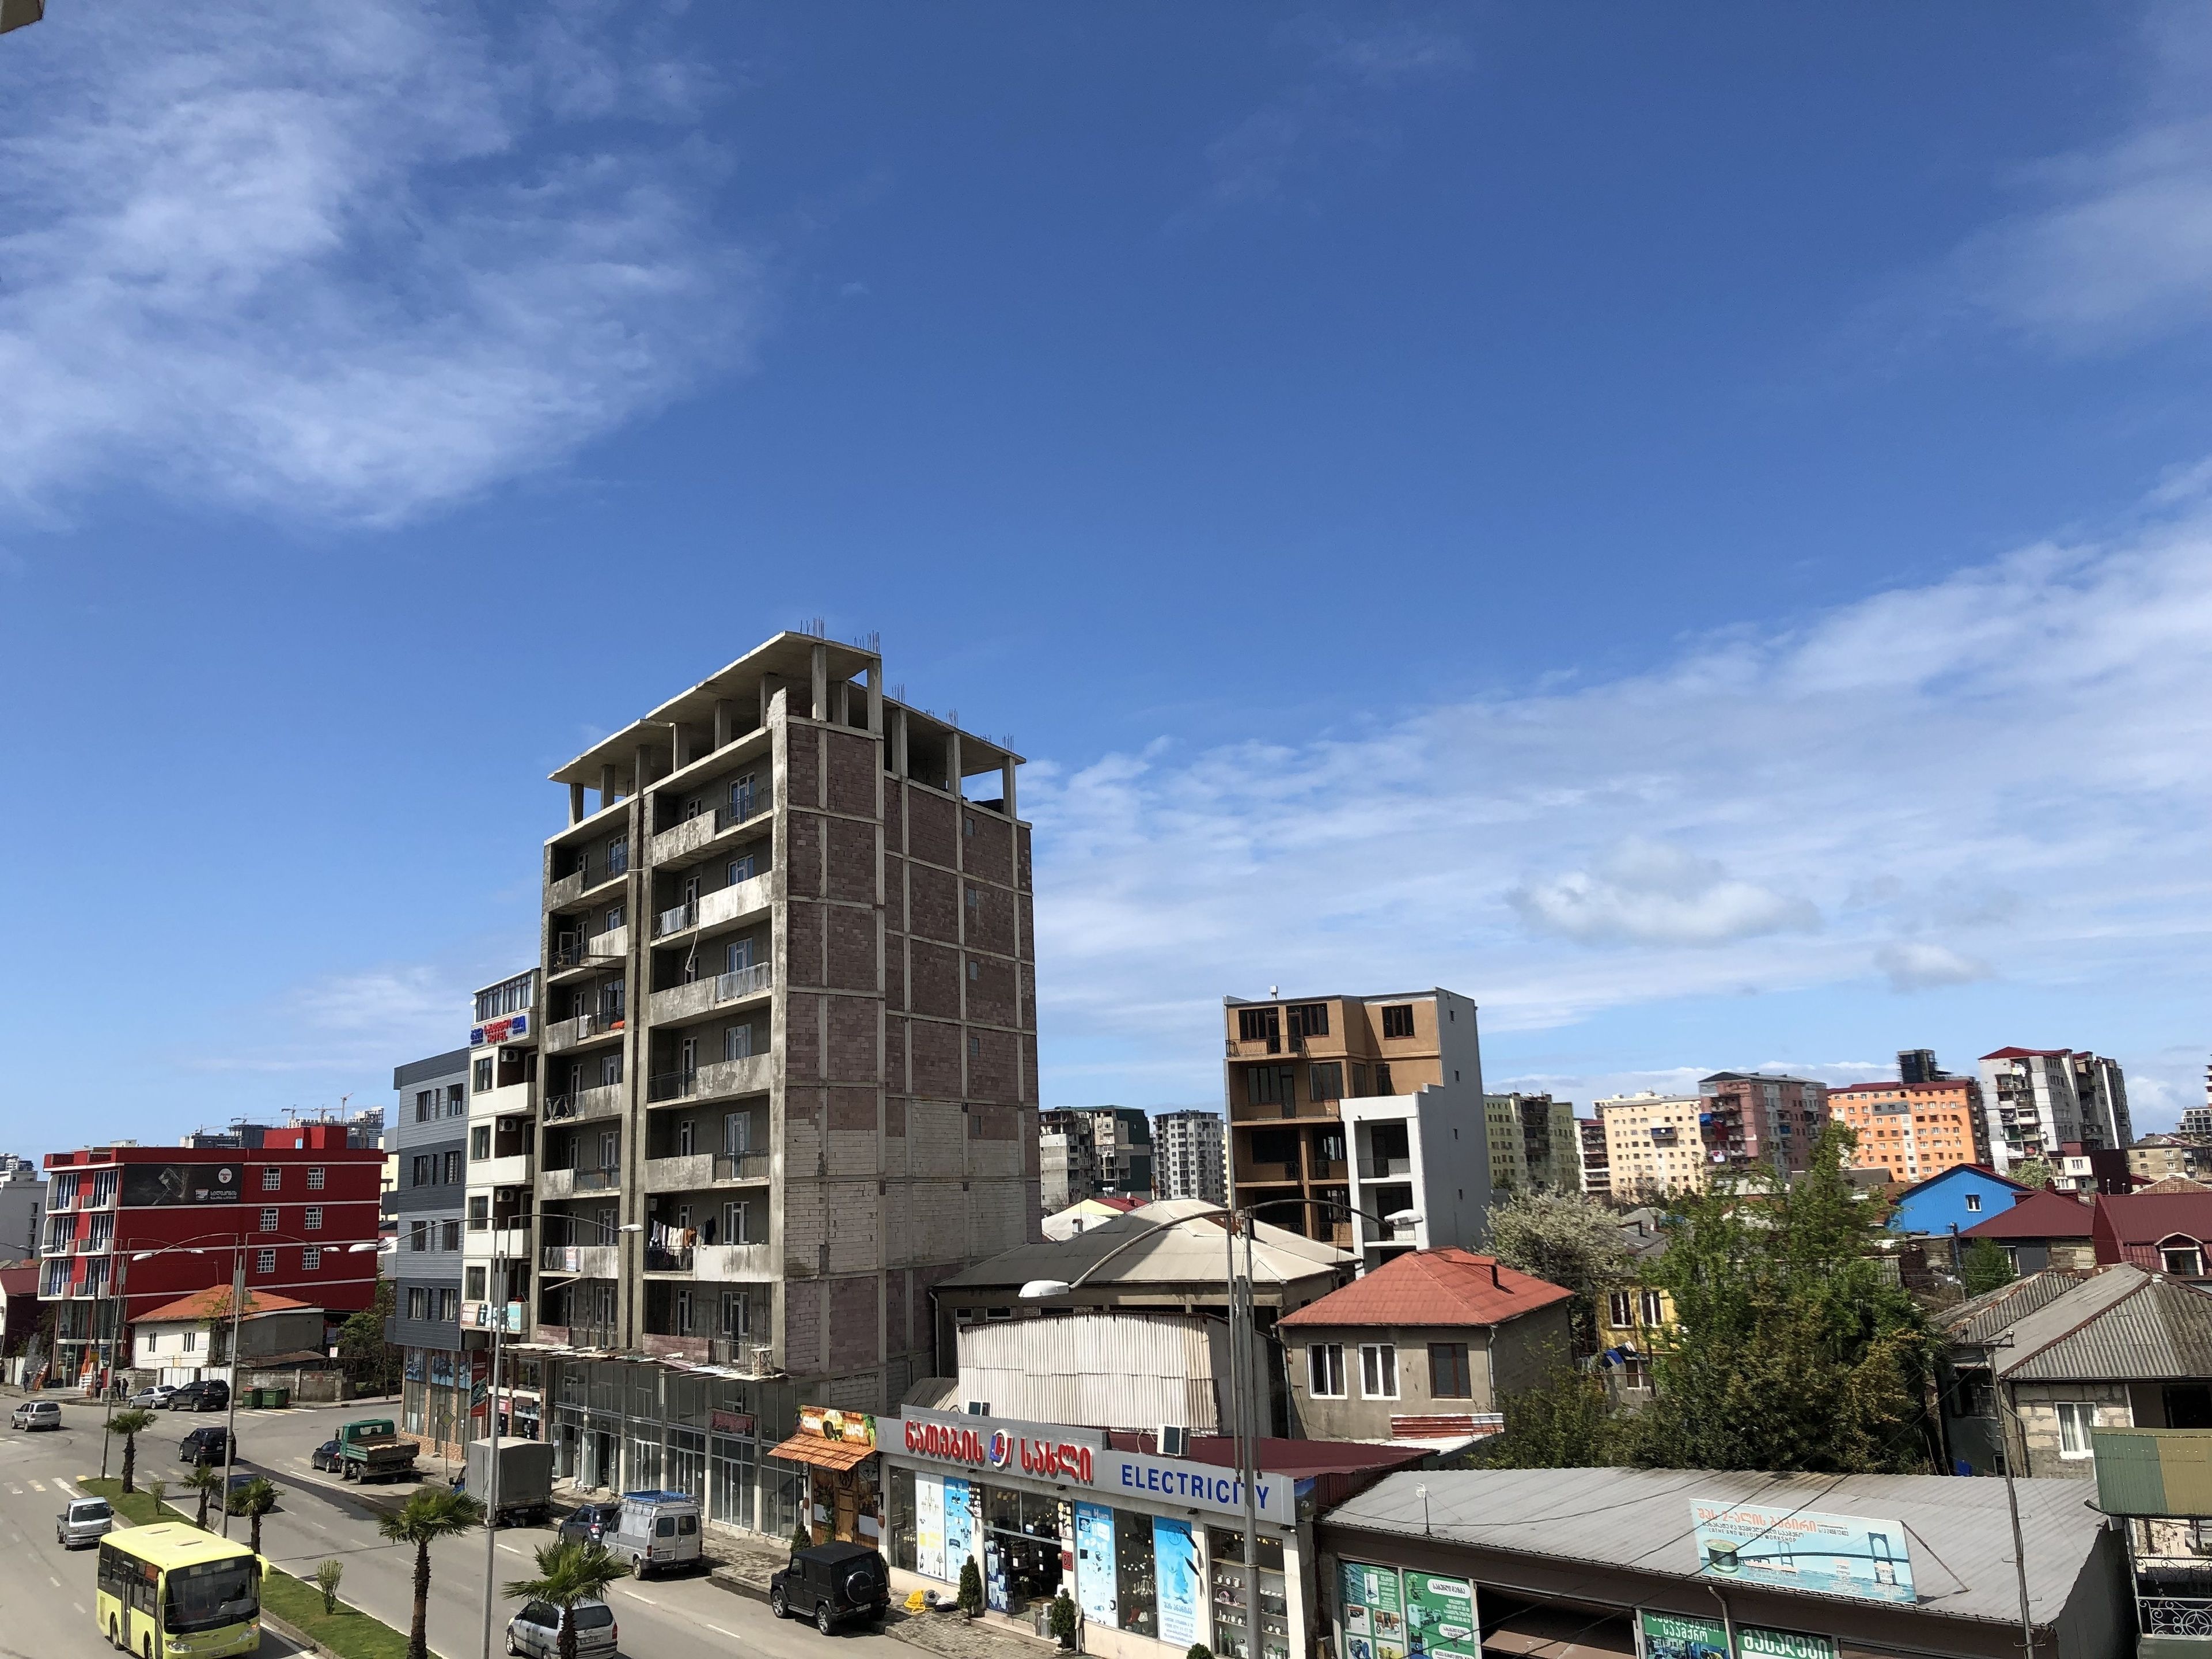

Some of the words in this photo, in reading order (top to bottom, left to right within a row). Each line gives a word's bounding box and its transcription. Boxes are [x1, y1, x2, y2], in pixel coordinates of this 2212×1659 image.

[487, 1031, 507, 1043] HOTEL
[904, 1420, 984, 1463] ნათების
[1020, 1437, 1093, 1481] სახლი
[1122, 1464, 1269, 1509] ELECTRICIY
[1764, 1535, 1797, 1543] WORKSHOP
[1662, 1623, 1708, 1642] საამქრო
[1743, 1628, 1830, 1659] მასალები
